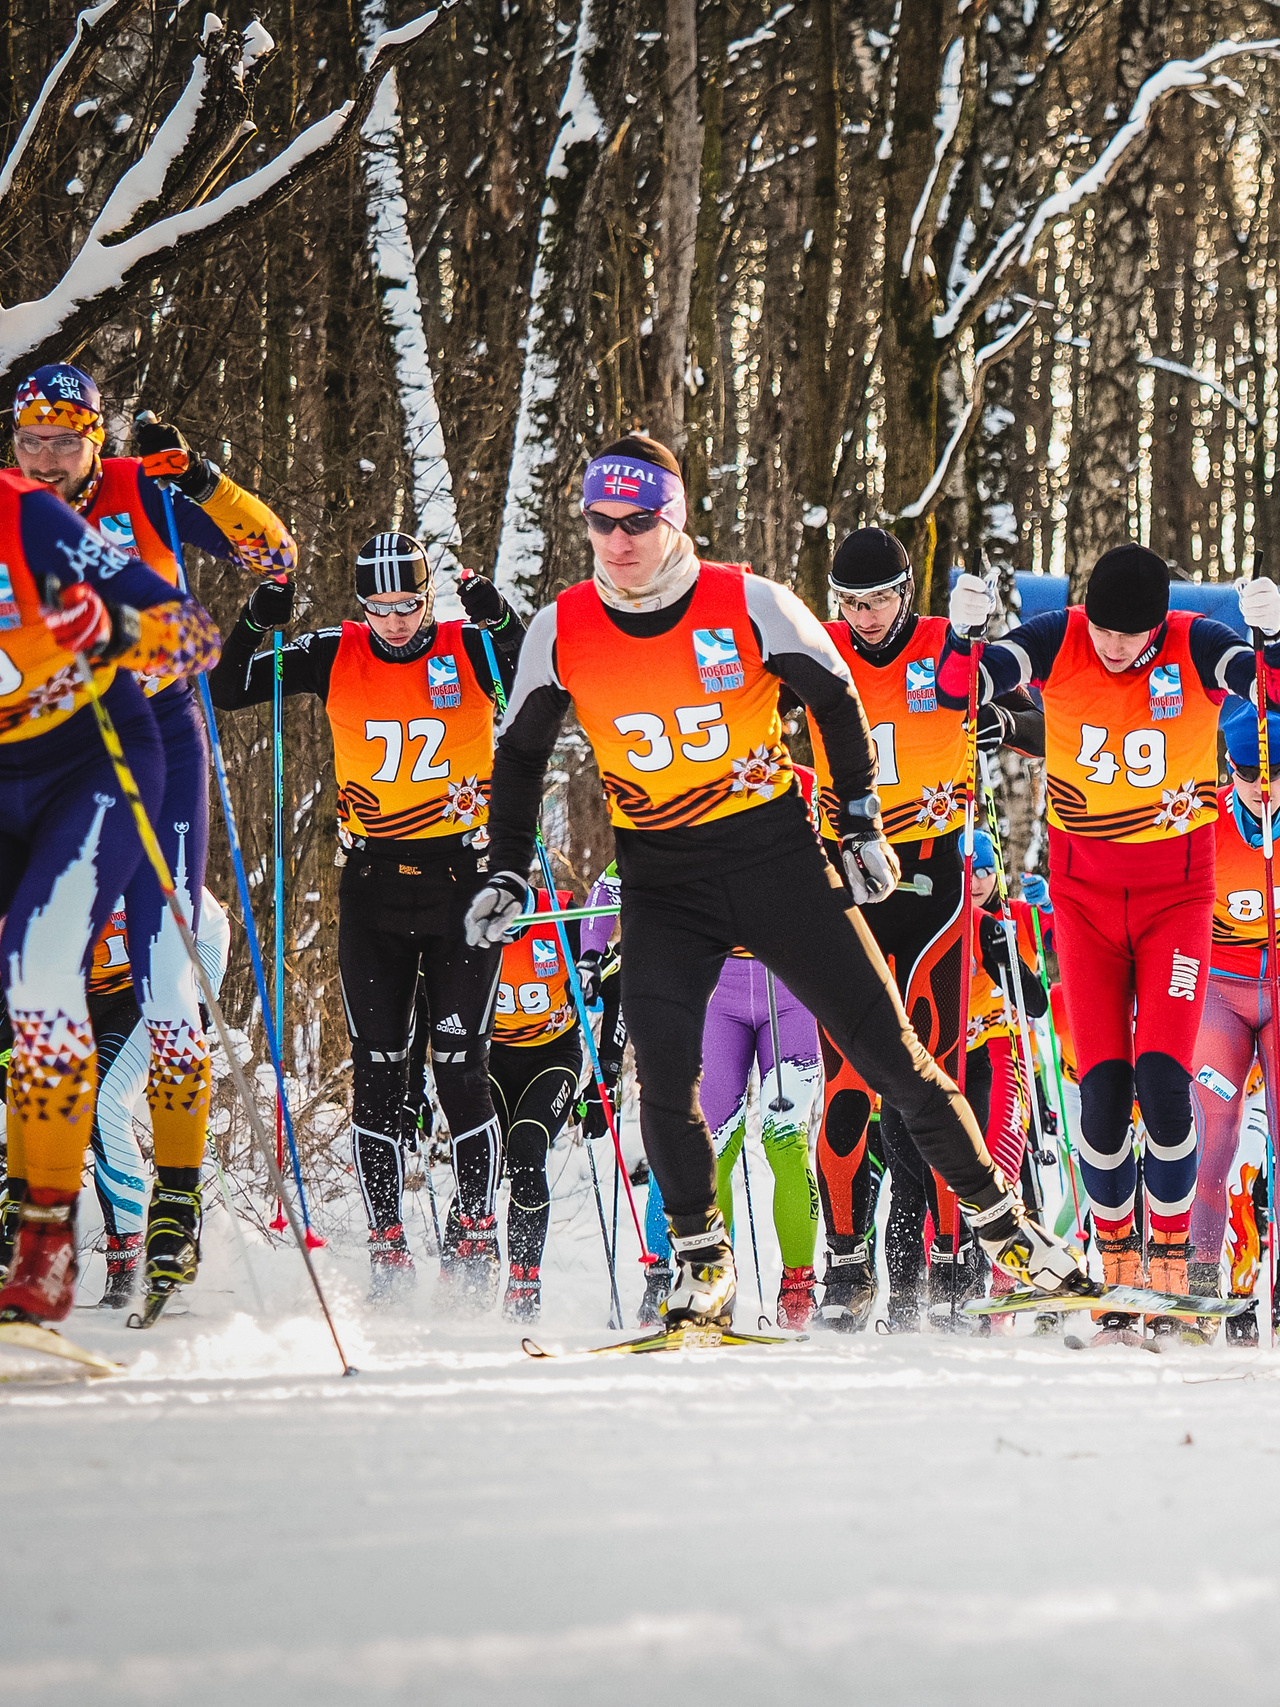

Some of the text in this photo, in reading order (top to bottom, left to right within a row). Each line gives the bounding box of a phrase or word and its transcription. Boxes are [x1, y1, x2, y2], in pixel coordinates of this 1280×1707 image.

[700, 663, 743, 679] ПОБЕДА!
[429, 683, 461, 696] ПОБЕДА!
[702, 674, 744, 694] 70 ЛЕТ
[431, 693, 461, 709] 70 ЛЕТ
[908, 699, 937, 713] 70 ЛЕТ
[1152, 704, 1182, 721] 70 ЛЕТ
[612, 702, 730, 772] 35
[365, 718, 451, 782] 72
[1076, 723, 1167, 788] 49
[437, 1023, 467, 1036] adidas
